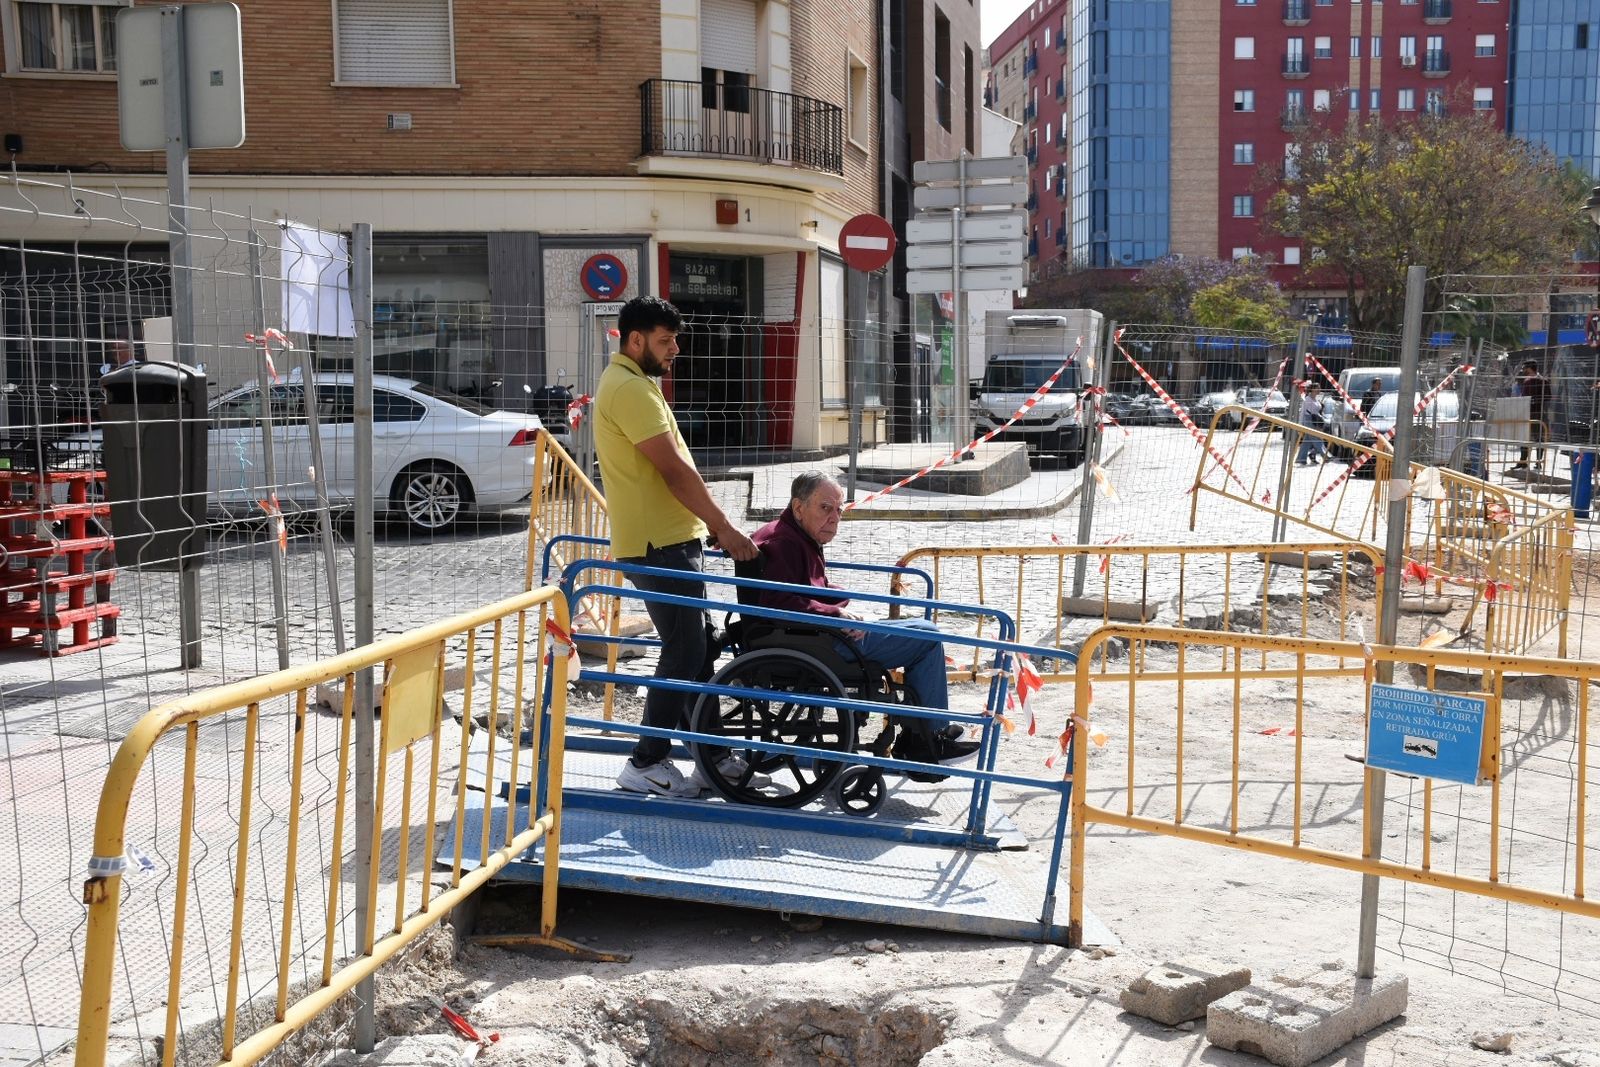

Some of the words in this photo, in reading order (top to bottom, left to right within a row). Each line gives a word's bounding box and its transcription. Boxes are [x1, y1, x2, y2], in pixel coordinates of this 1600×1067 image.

[74, 198, 85, 214] 2
[744, 208, 751, 222] 1
[685, 263, 716, 275] BAZAR
[668, 282, 681, 293] an
[1325, 337, 1353, 345] Allianz
[1373, 687, 1429, 703] PROHIBIDO
[1431, 695, 1481, 712] APARCAR
[1373, 700, 1391, 709] POR
[1393, 702, 1435, 716] MOTIVOS
[1437, 709, 1449, 718] DE
[1451, 711, 1479, 723] OBRA
[1372, 710, 1384, 719] EN
[1386, 712, 1411, 724] ZONA
[1412, 715, 1474, 734] SEÑALIZADA.
[1386, 722, 1430, 737] RETIRADA
[1431, 729, 1458, 743] GRÚA
